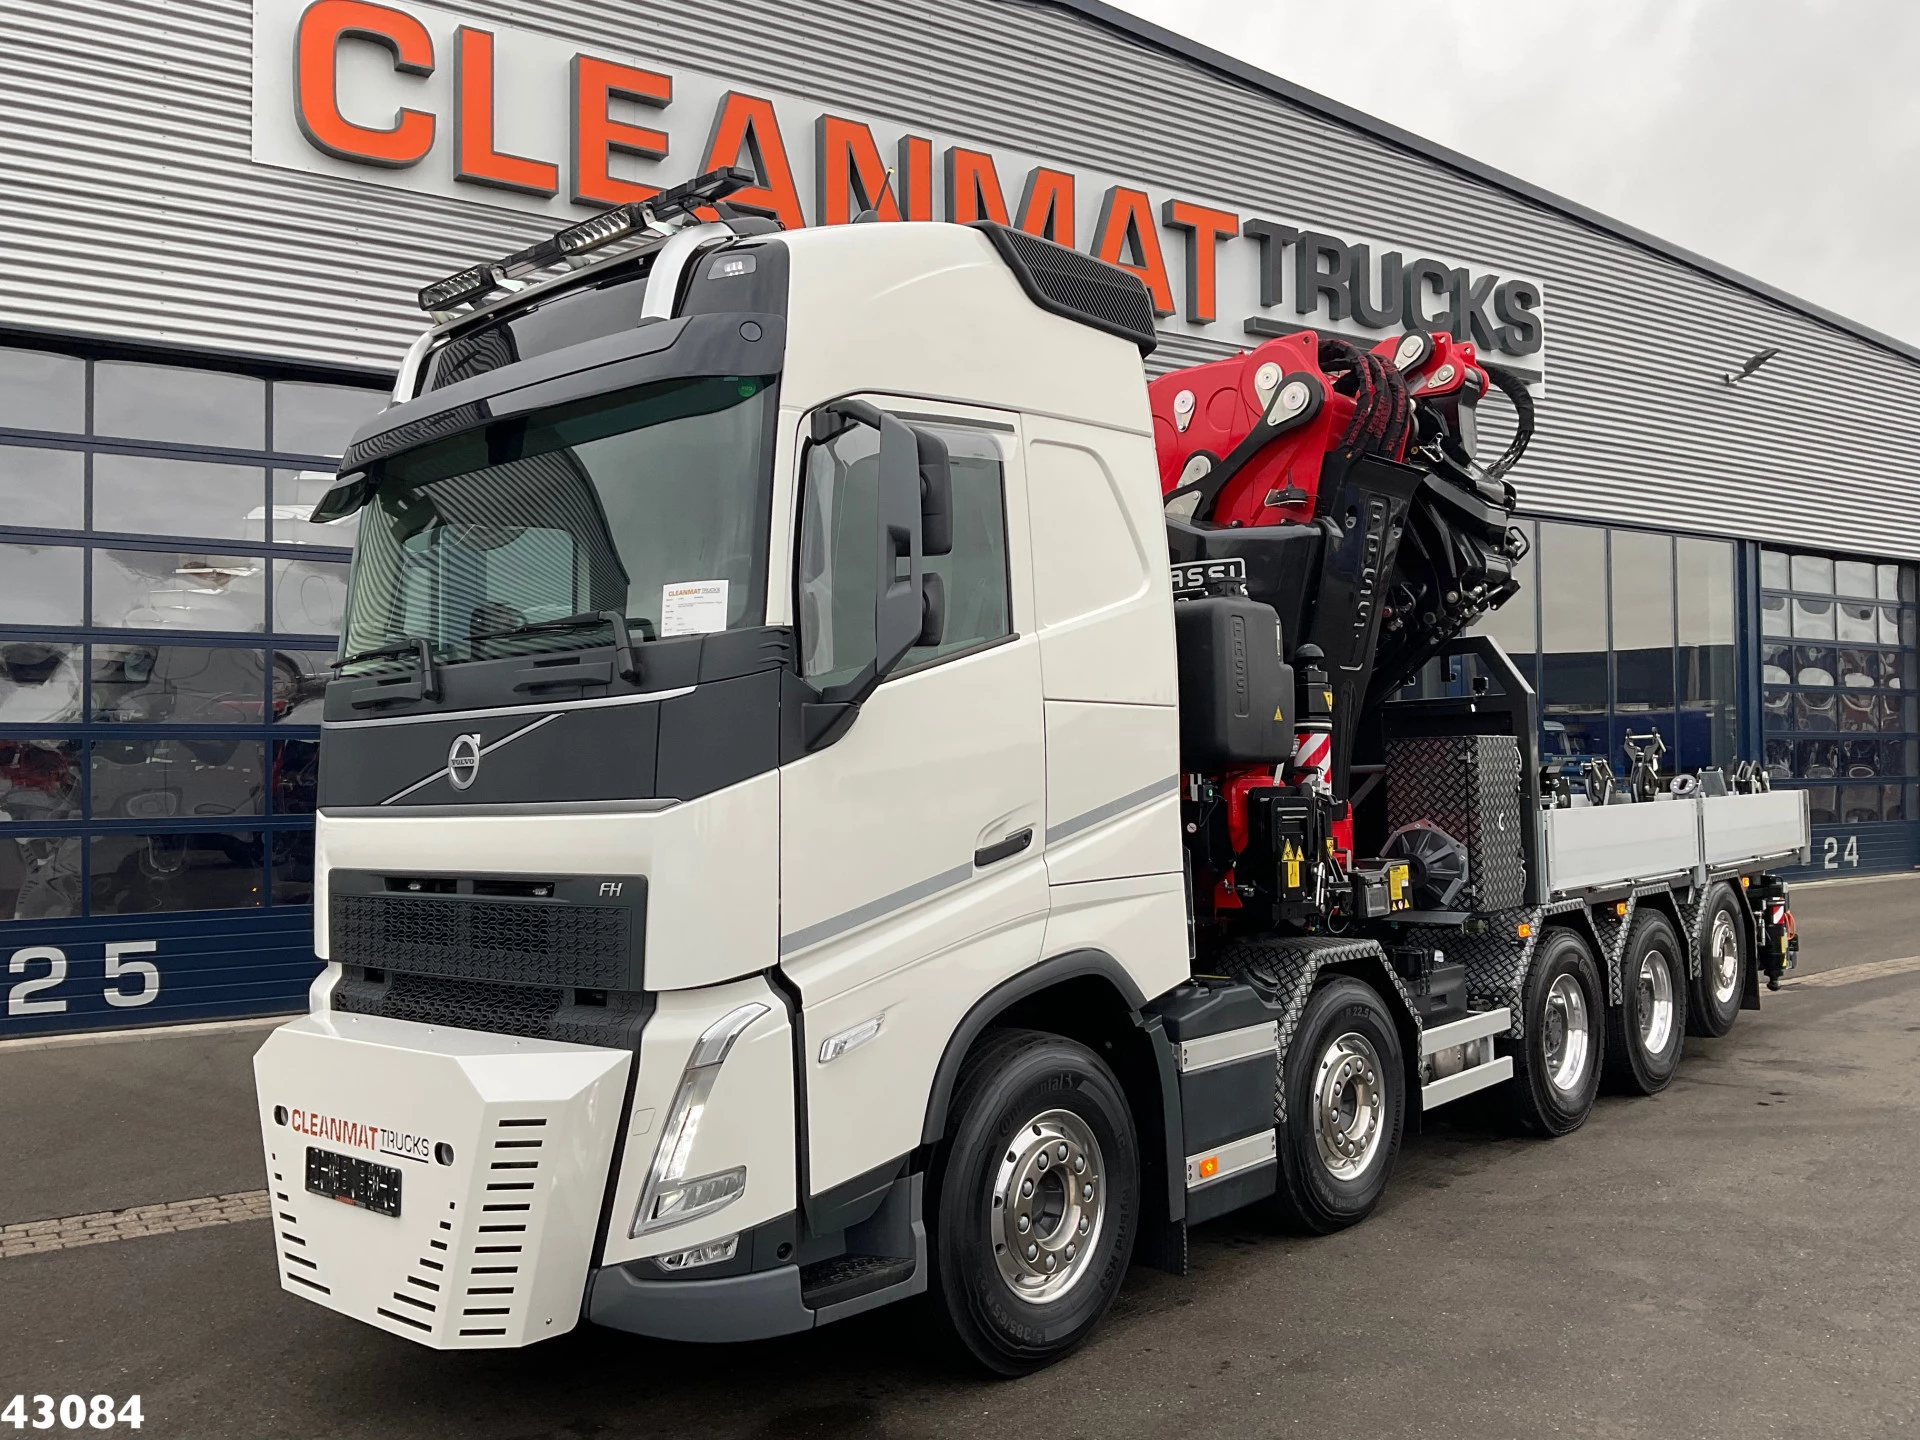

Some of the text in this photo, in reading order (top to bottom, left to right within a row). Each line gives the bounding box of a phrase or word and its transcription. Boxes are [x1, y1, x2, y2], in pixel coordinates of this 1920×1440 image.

[294, 0, 1543, 356] CLEANMAT TRUCKS
[1172, 565, 1236, 587] ASSI
[668, 588, 701, 597] CLEANMAT
[451, 758, 475, 766] VOLVO
[1824, 835, 1859, 869] 24
[599, 882, 622, 896] FH
[292, 1109, 429, 1157] CLEANMAT TRUCKS
